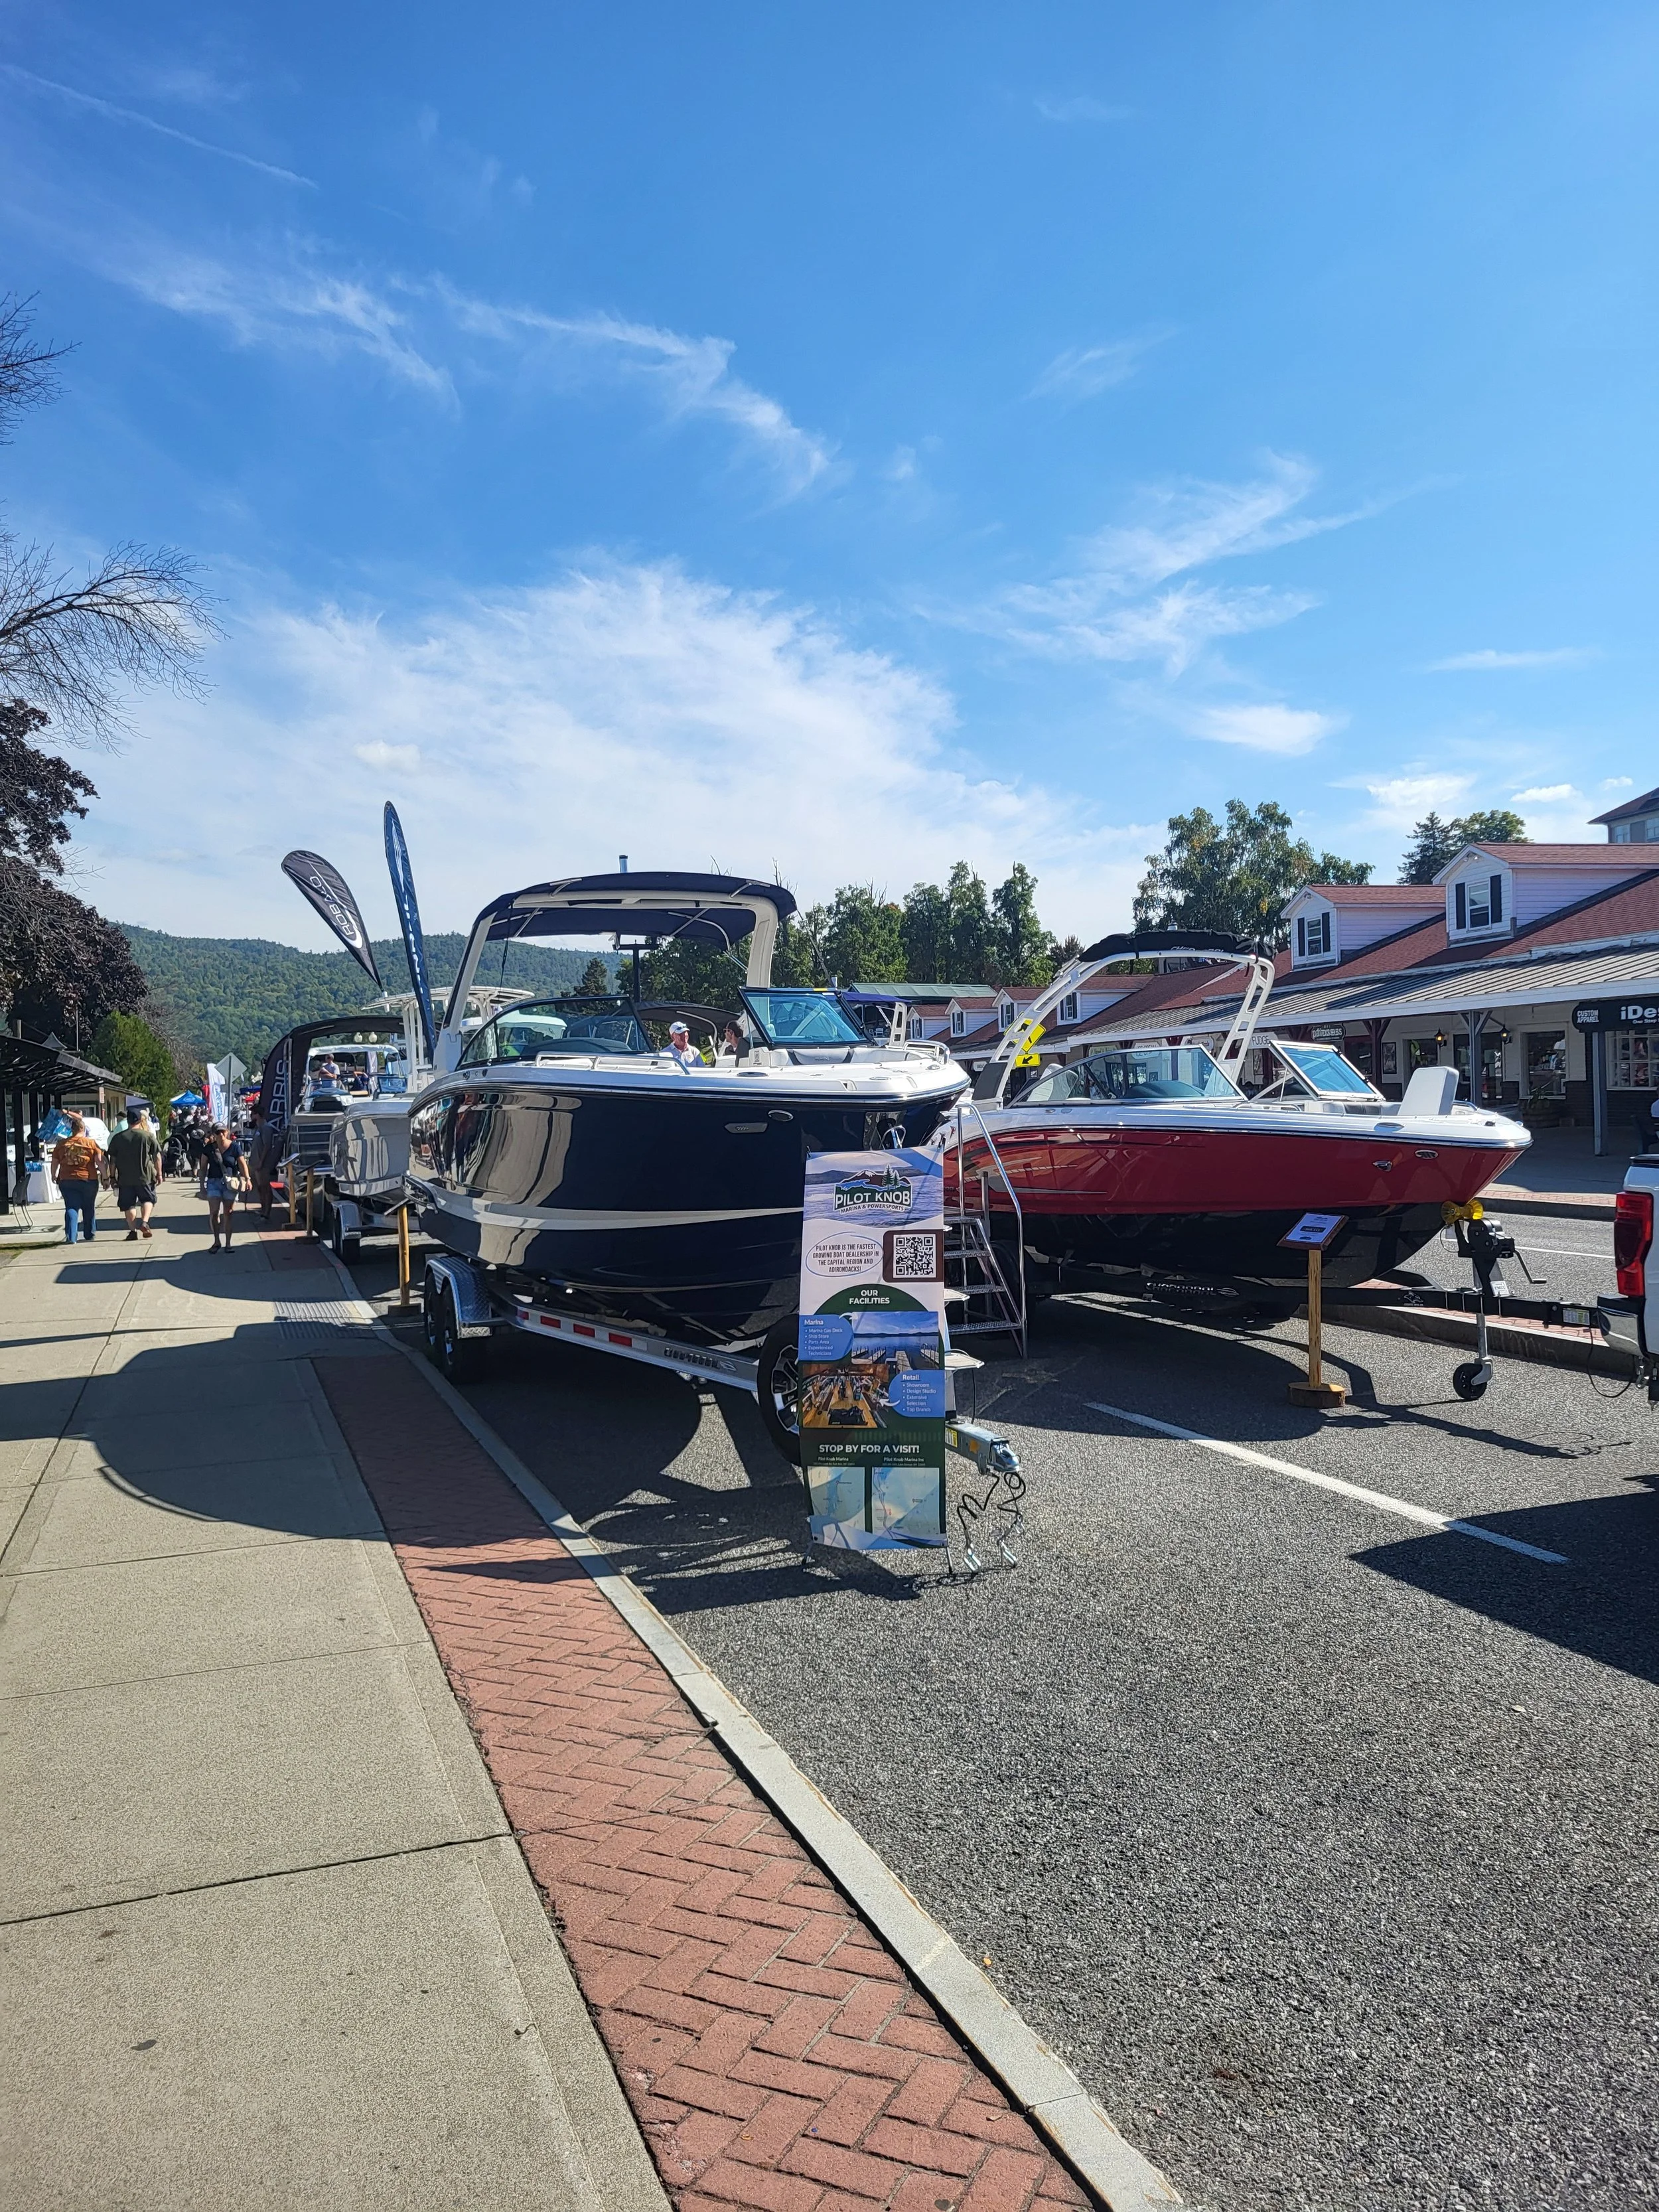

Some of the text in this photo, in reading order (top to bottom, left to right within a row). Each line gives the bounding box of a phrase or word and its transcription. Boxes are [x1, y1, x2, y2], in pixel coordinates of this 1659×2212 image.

[1620, 1005, 1659, 1020] iDe
[1252, 1035, 1270, 1045] FUDGE
[835, 1191, 910, 1209] PILOT KNOB
[841, 1205, 861, 1214] MARINA
[819, 1444, 919, 1453] STOP BY FOR A VISIT!
